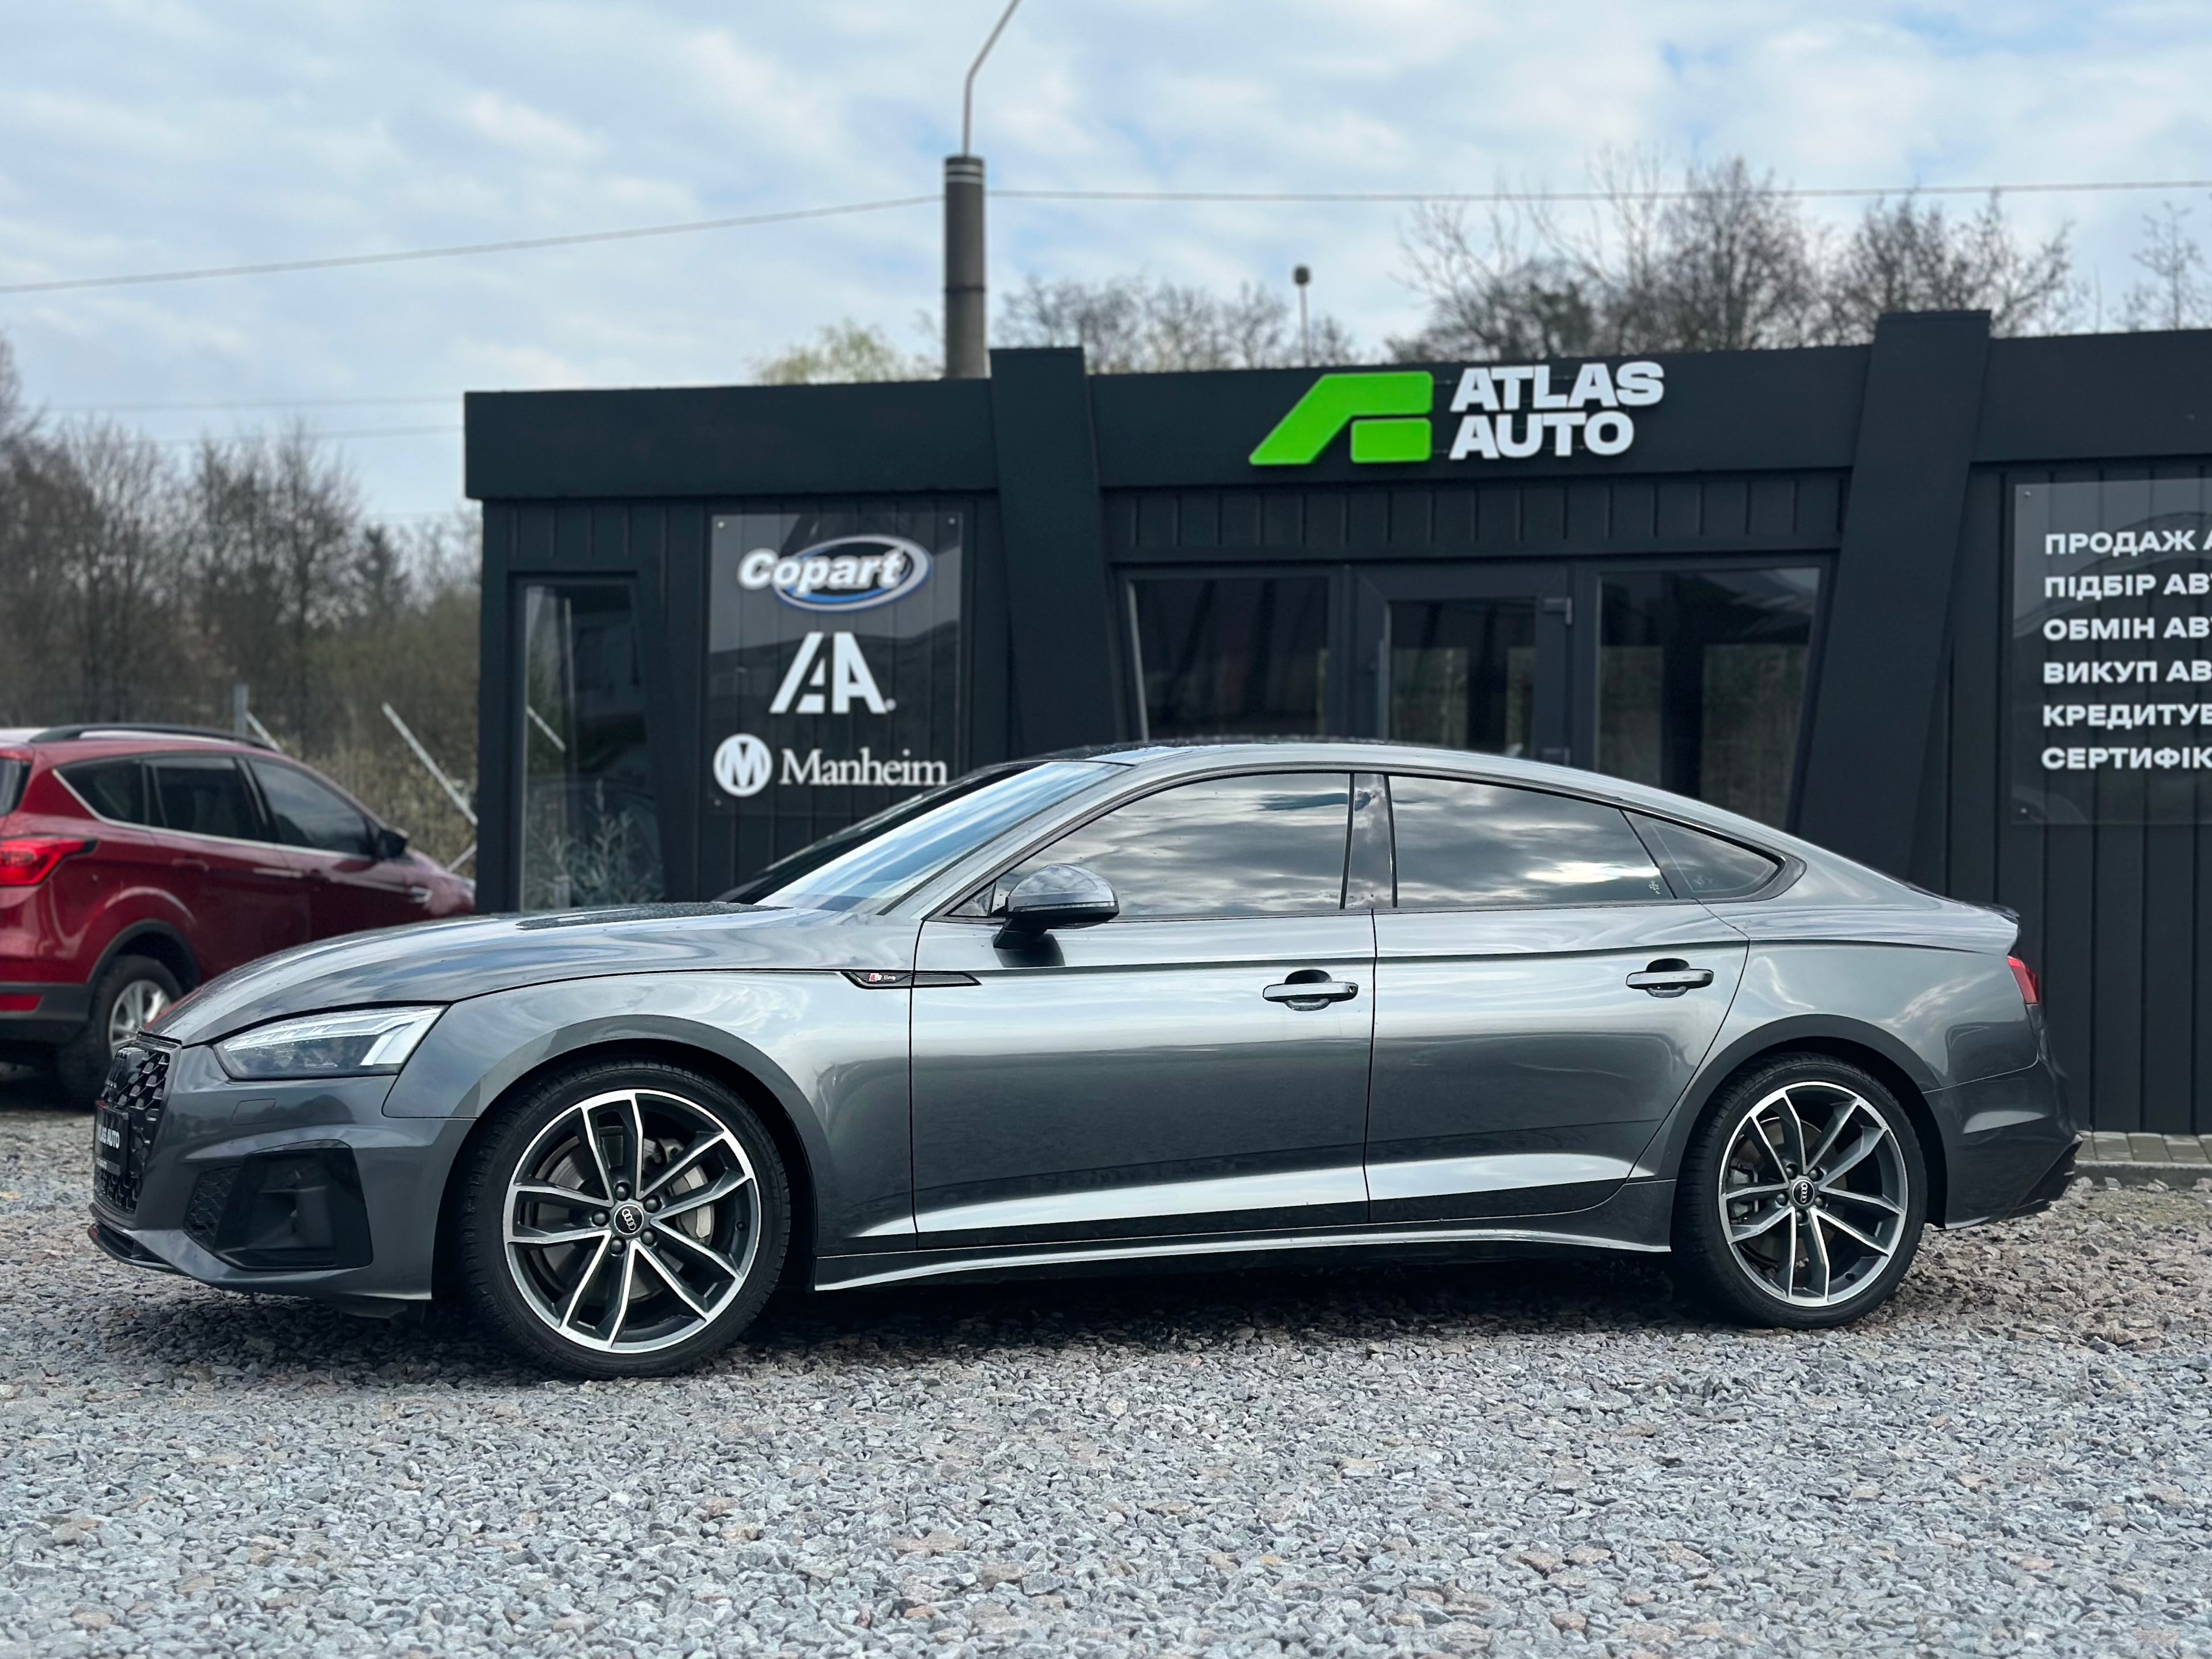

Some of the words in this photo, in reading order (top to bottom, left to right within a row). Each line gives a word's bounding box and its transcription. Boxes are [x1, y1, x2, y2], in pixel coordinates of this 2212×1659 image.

[1450, 361, 1664, 413] ATLAS
[1449, 411, 1634, 460] AUTO
[2045, 529, 2196, 557] ПРОДАЖ
[738, 548, 906, 597] Copart
[2044, 574, 2156, 601] ПІДБІР
[2163, 573, 2212, 596] АВ
[2043, 618, 2155, 641] ОБМІН
[2163, 616, 2212, 639] АВ
[2043, 661, 2157, 684] ВИКУП
[779, 747, 948, 786] Manheim
